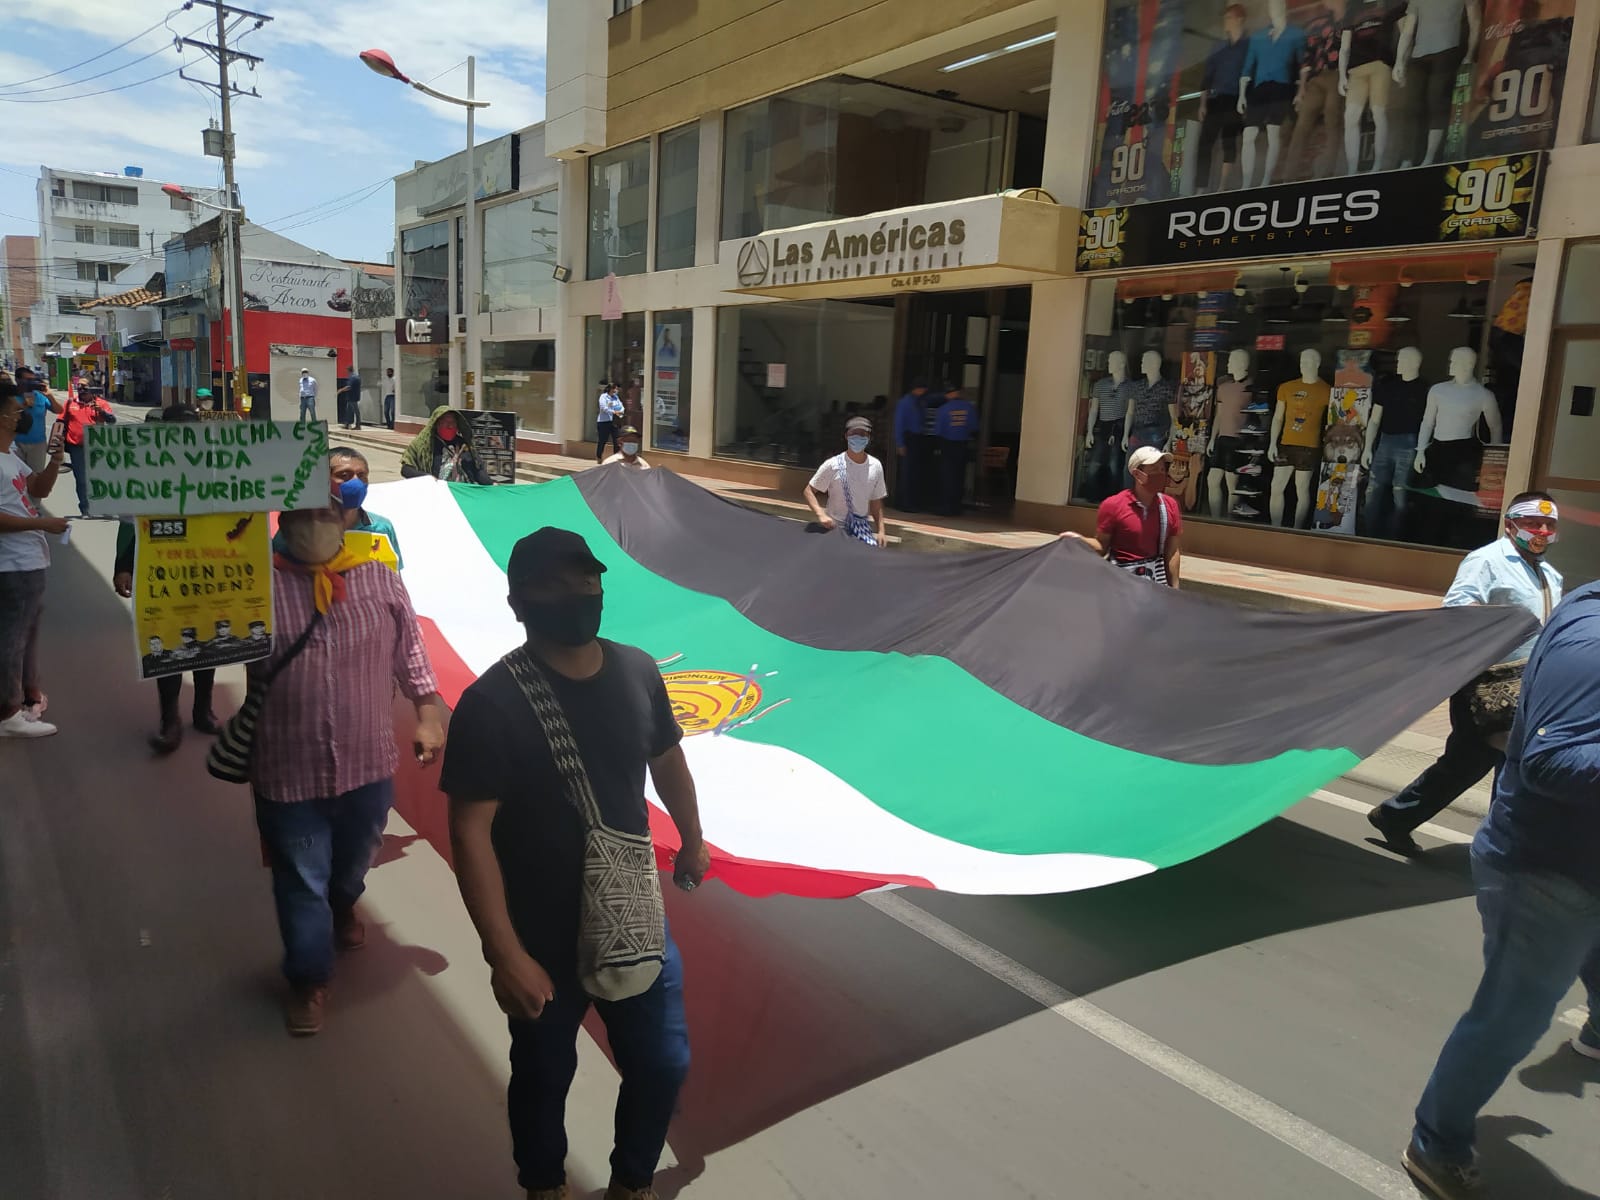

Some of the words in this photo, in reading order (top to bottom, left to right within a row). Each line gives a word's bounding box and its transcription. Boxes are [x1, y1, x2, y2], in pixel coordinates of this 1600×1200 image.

[1168, 189, 1381, 240] ROGUES
[1448, 214, 1518, 228] GRADOS
[773, 238, 813, 267] Las
[821, 218, 965, 261] Américas
[1179, 226, 1354, 249] STRETSTYLE
[250, 267, 340, 288] Restaurante
[263, 285, 317, 308] Arcos
[88, 424, 198, 448] NUESTRA
[204, 420, 282, 446] LUCHA
[293, 421, 323, 443] ES
[89, 450, 140, 471] POR
[145, 451, 175, 467] LA
[184, 450, 252, 470] VIDA
[152, 522, 184, 535] 255
[149, 584, 170, 598] LA
[180, 578, 255, 597] ORDEN?
